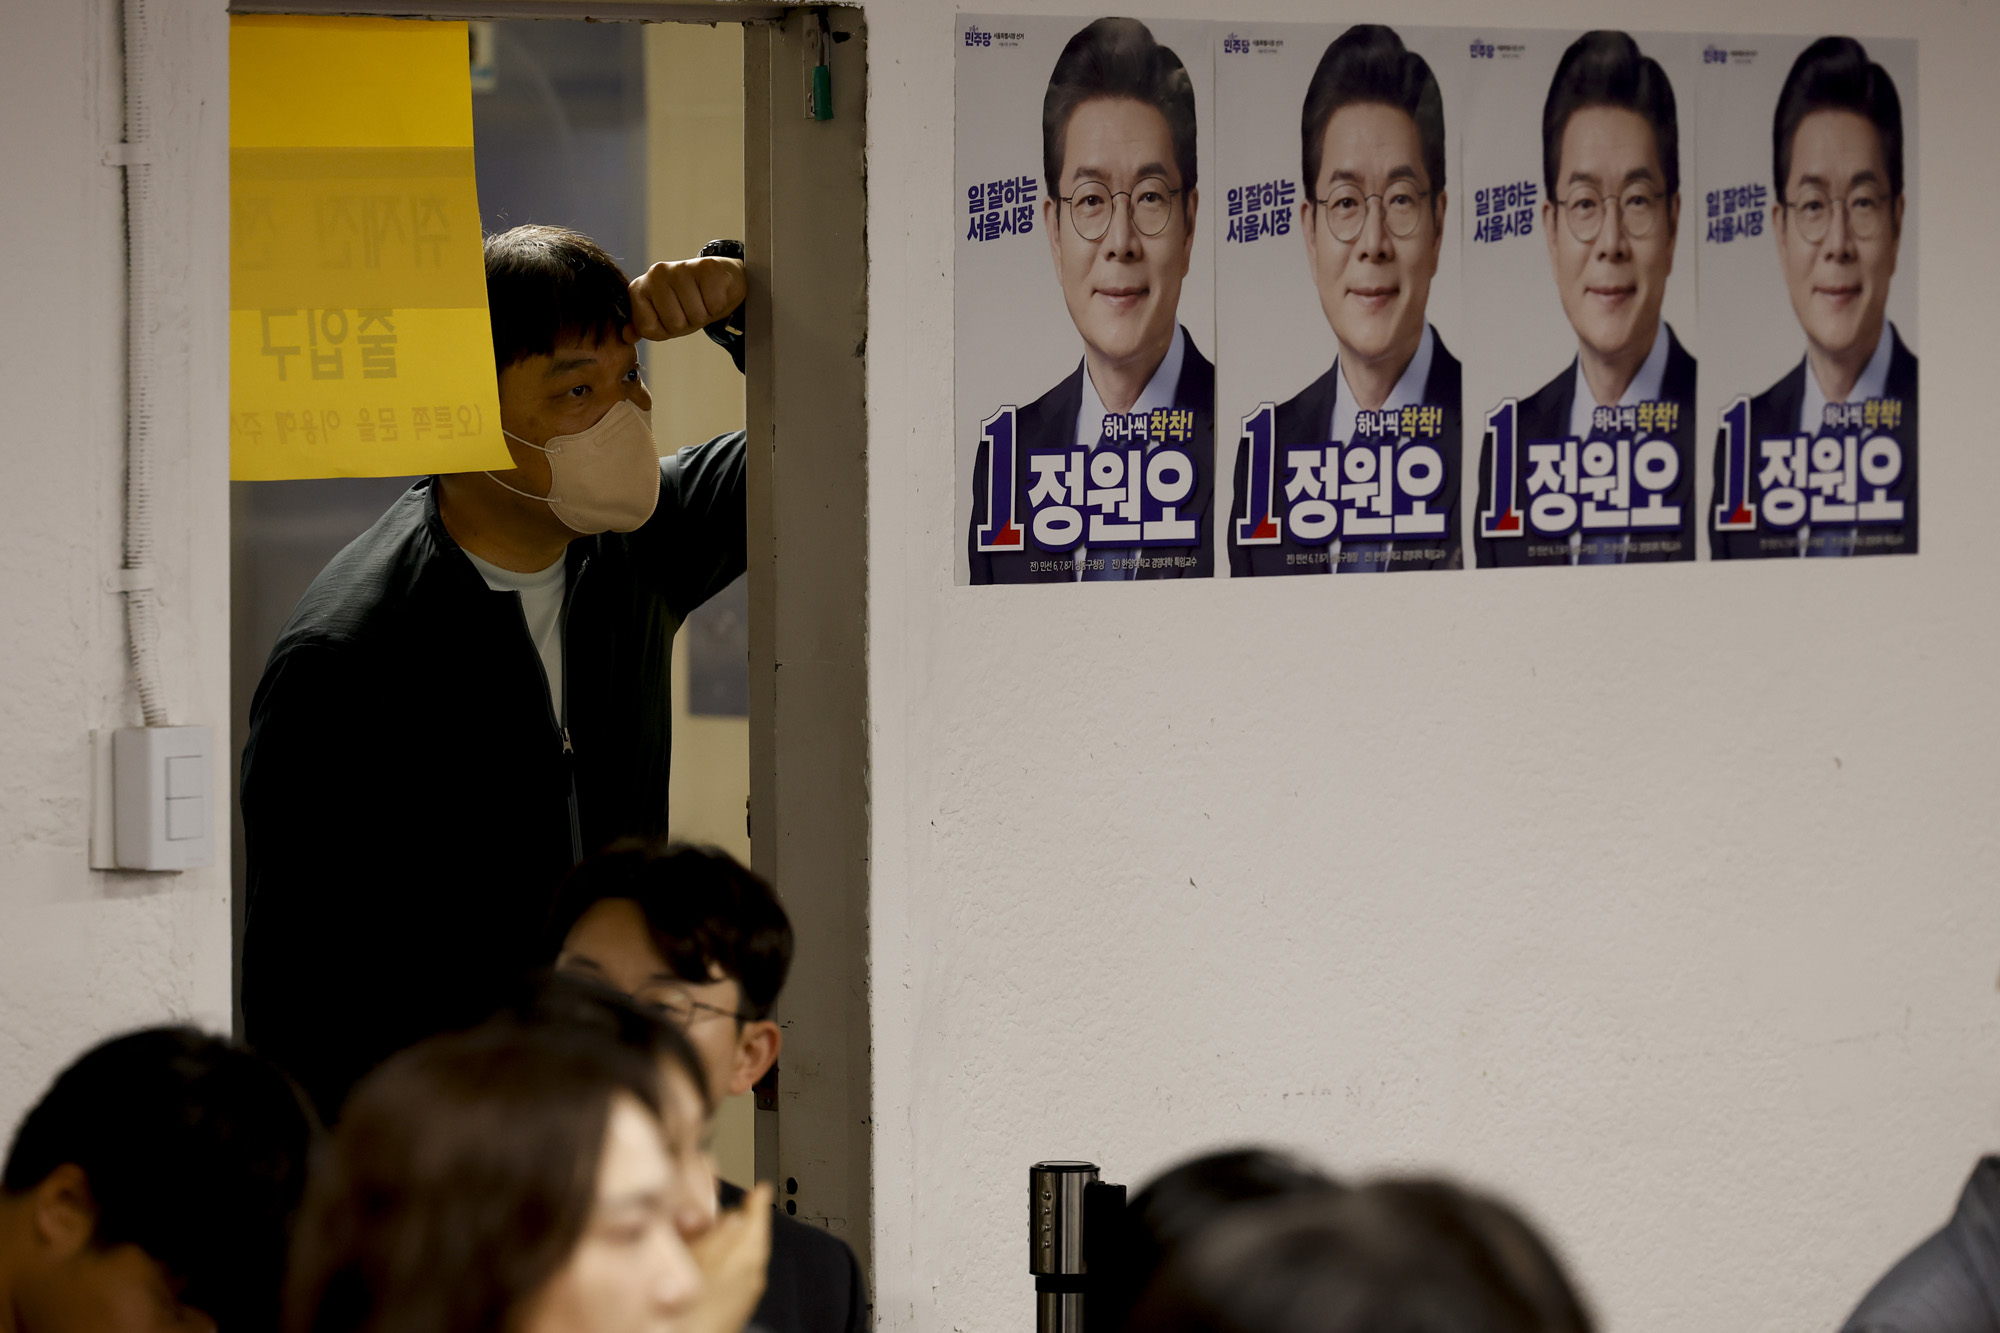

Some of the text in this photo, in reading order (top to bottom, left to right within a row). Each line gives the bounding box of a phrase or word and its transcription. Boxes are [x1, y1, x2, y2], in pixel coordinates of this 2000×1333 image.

[965, 32, 992, 47] 민주당
[967, 204, 1035, 242] 서울시장
[1226, 206, 1292, 243] 서울시장
[1474, 207, 1534, 243] 서울시장
[1104, 409, 1194, 442] 하나씩 착착!
[1357, 405, 1443, 438] 하나씩 착착!
[1715, 394, 1757, 531] 1
[977, 405, 1024, 552] 1
[1027, 450, 1196, 546] 정원오
[1236, 402, 1281, 545] 1
[1284, 445, 1446, 539] 정원오
[1481, 397, 1524, 538] 1
[1525, 440, 1681, 532] 정원오
[1758, 436, 1904, 525] 정원오
[1040, 561, 1052, 572] 민선
